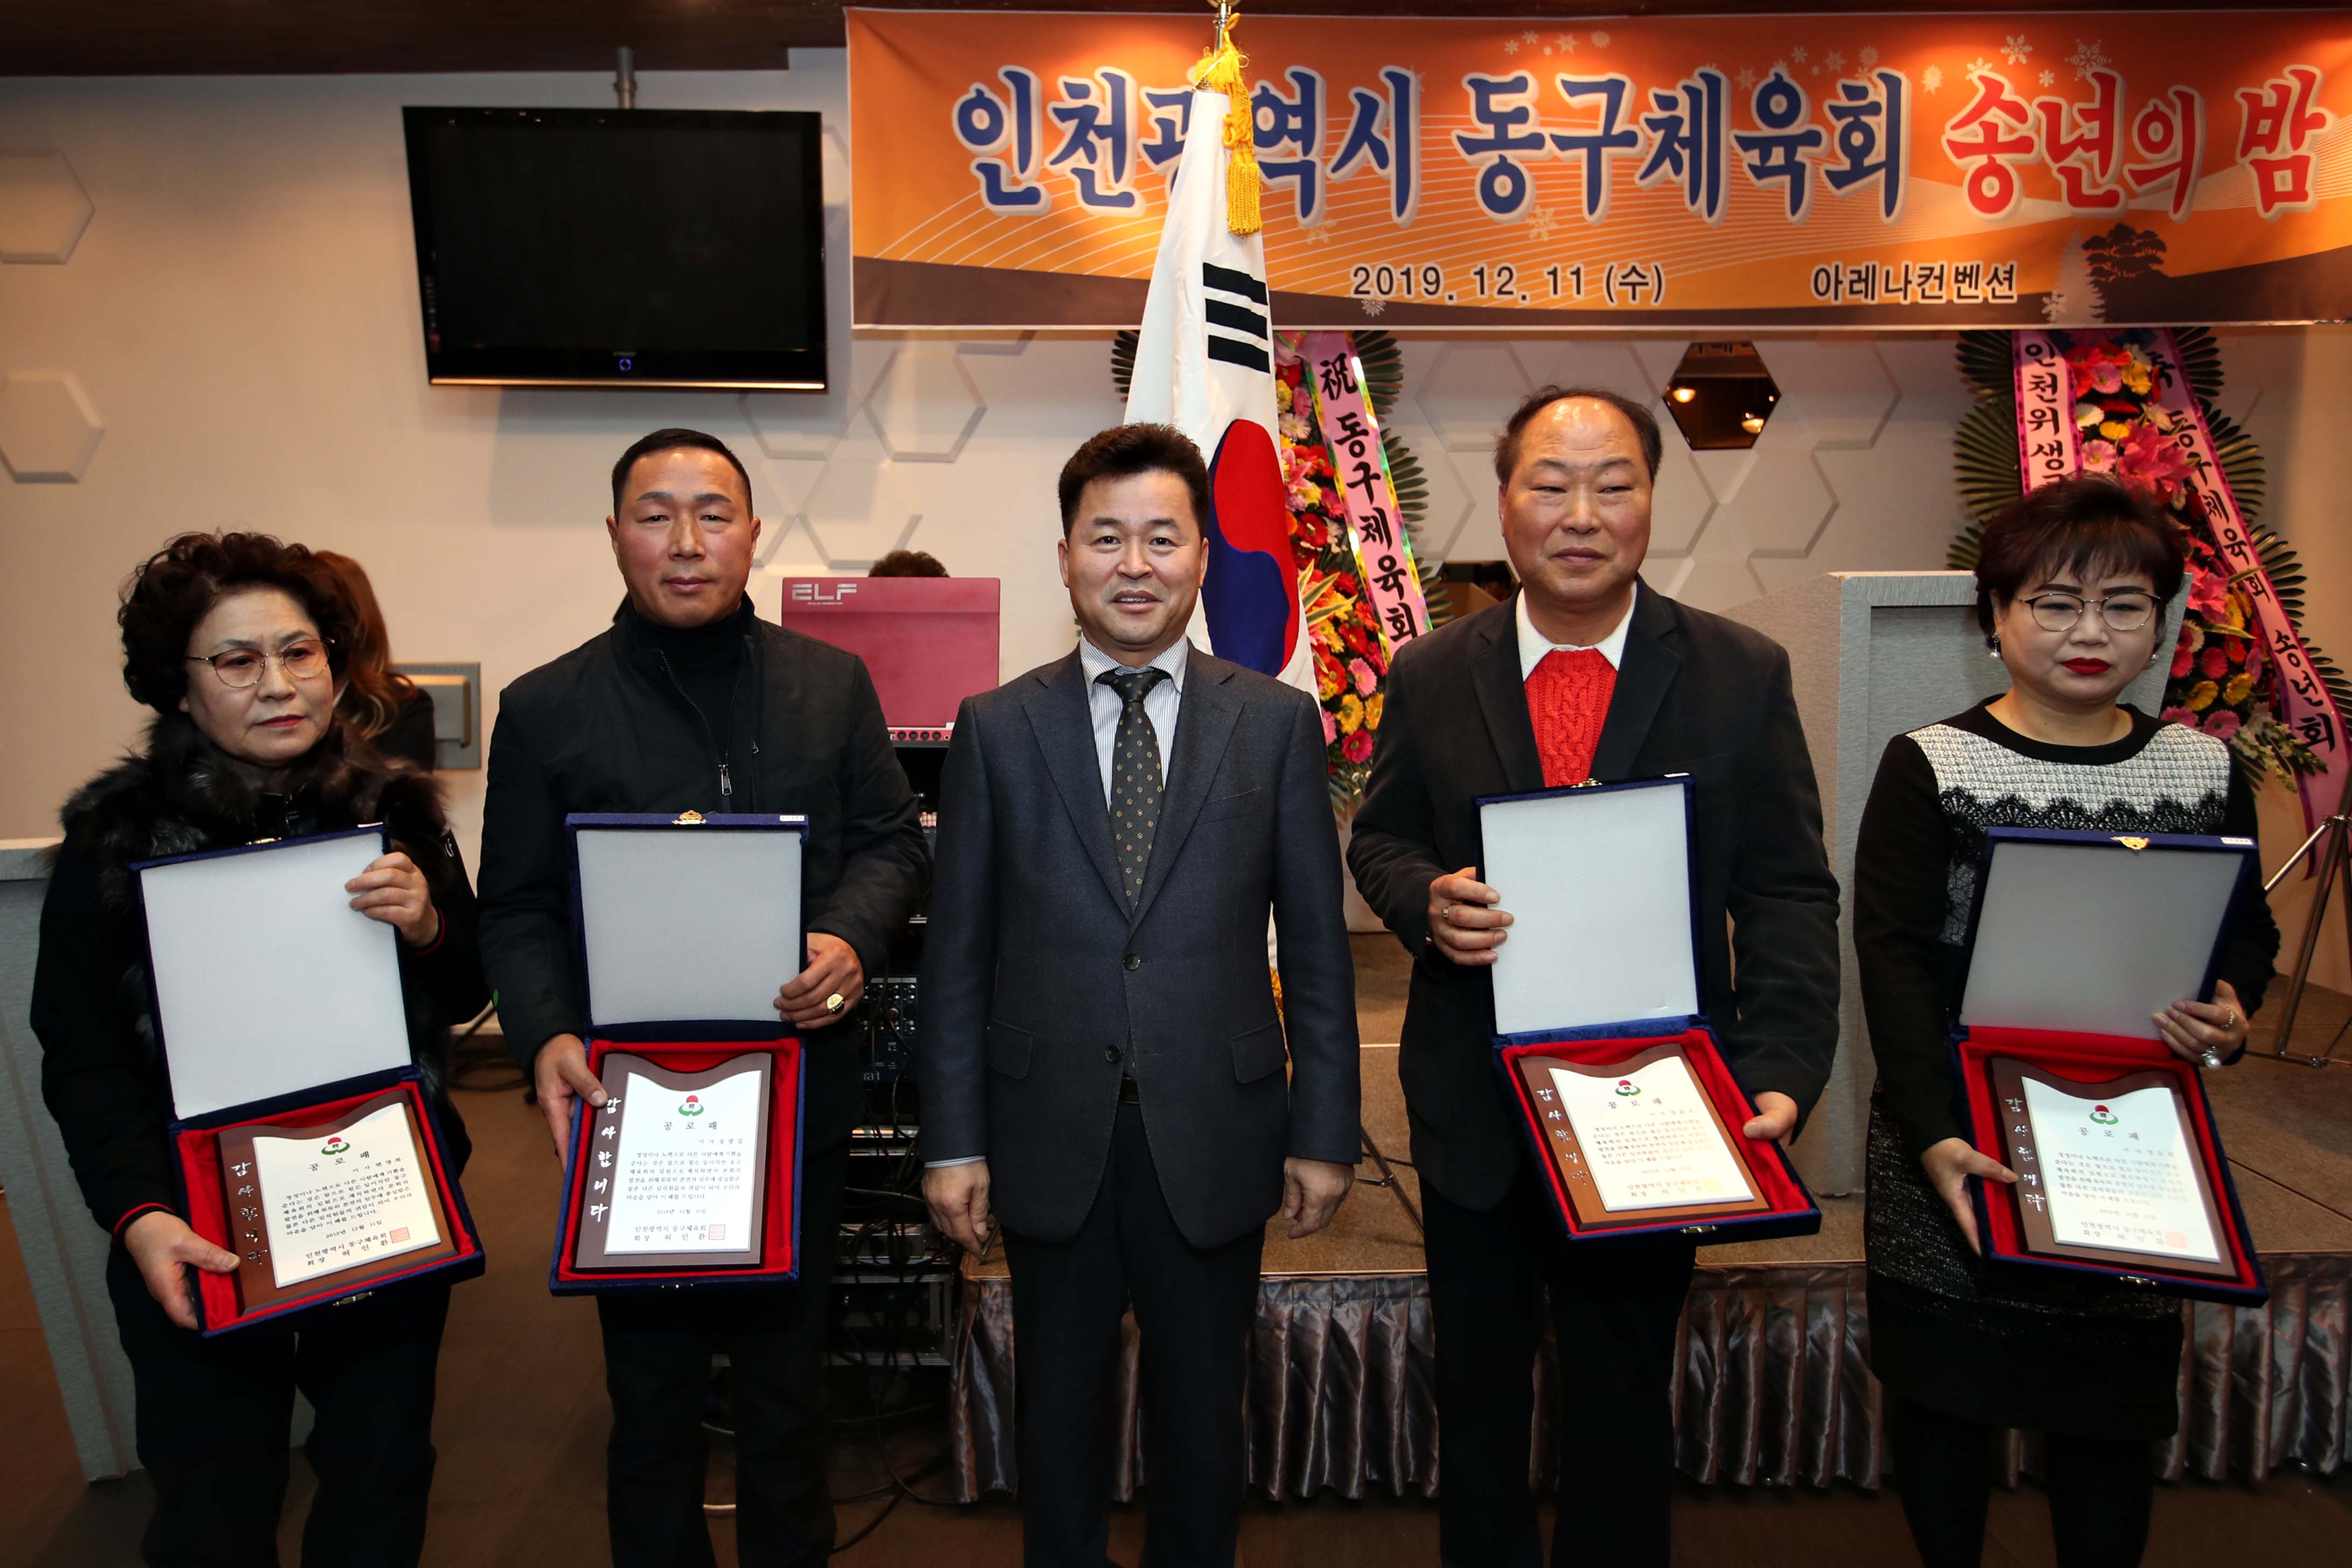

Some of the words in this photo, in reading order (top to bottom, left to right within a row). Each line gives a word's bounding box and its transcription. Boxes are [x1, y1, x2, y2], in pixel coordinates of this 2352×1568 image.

[1453, 69, 1904, 221] 동구체육회
[1946, 68, 2197, 216] 송년의
[2238, 67, 2329, 215] 밤
[1546, 265, 1585, 298] 11
[1605, 263, 1664, 304] (수)
[1812, 262, 2017, 303] 아레나컨벤션
[1319, 352, 1359, 401] 祝
[1334, 411, 1418, 643] 동구체육회
[792, 583, 857, 600] ELF
[2274, 629, 2336, 753] 송년회
[590, 1097, 622, 1222] 감사합니다
